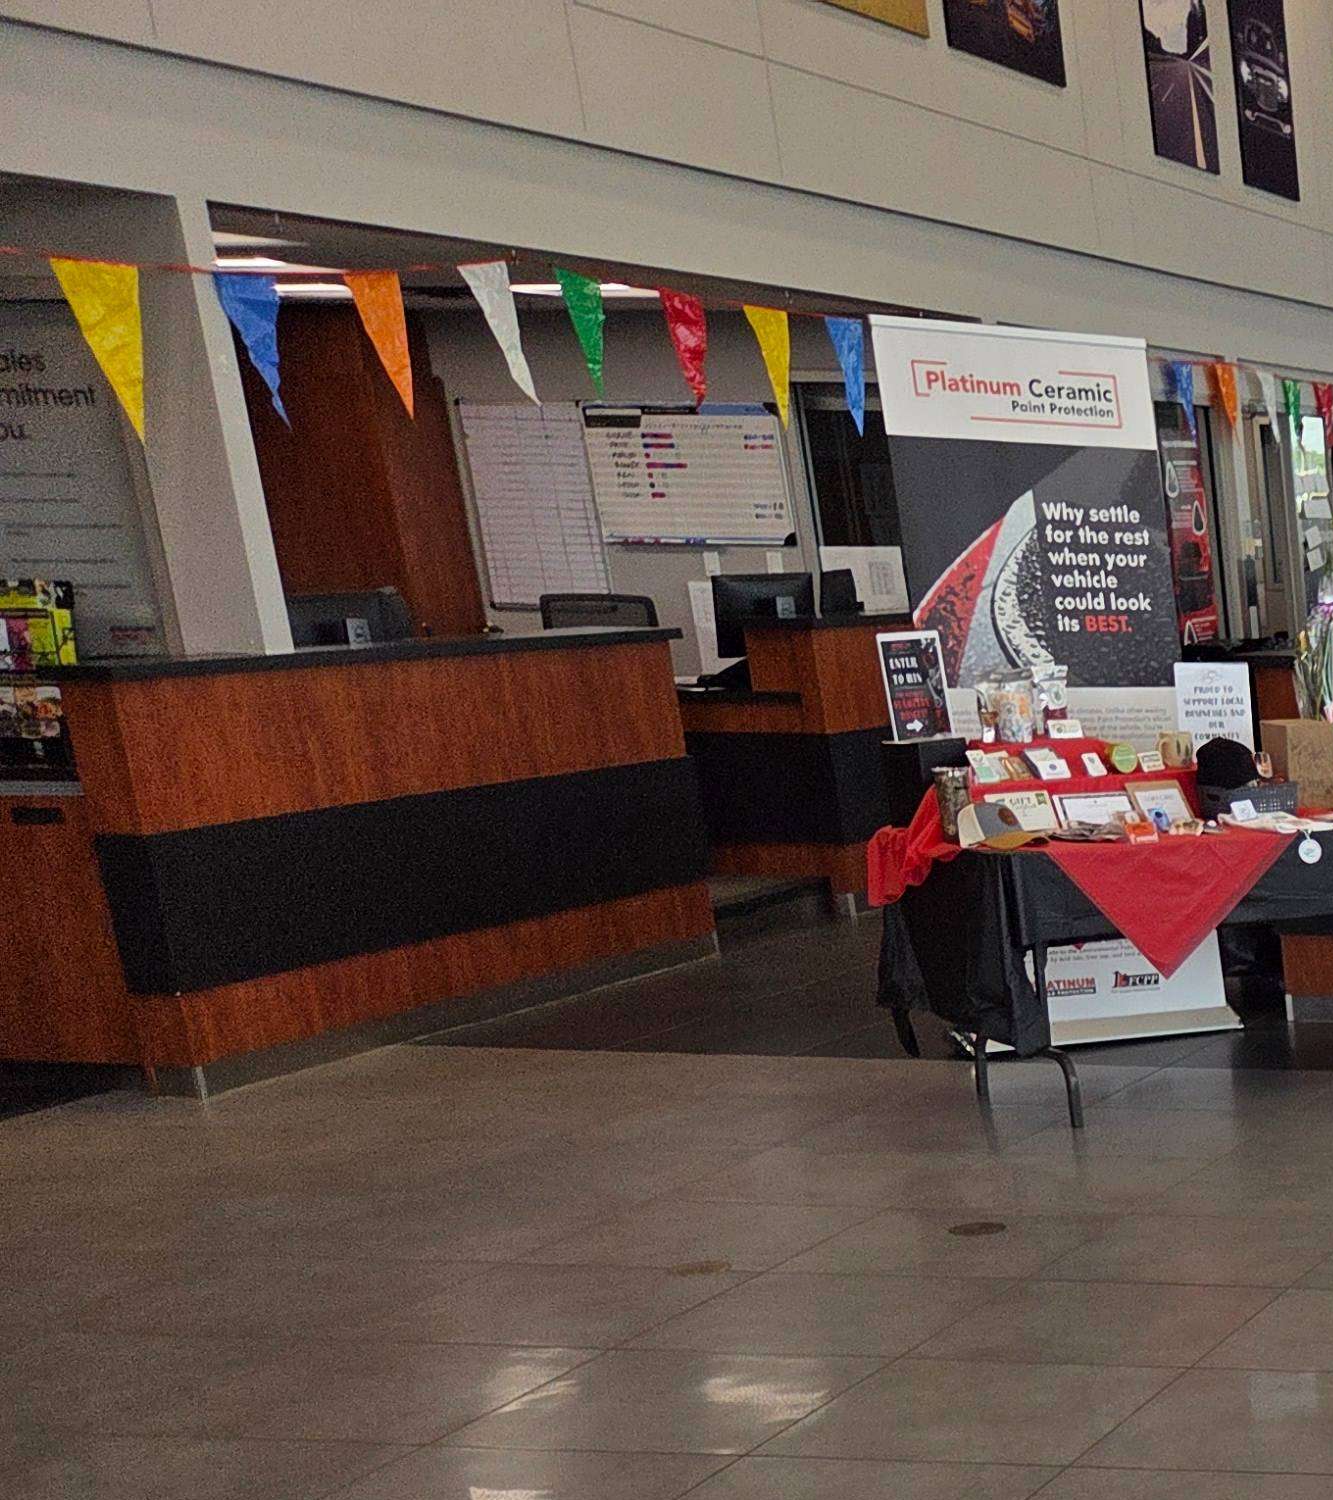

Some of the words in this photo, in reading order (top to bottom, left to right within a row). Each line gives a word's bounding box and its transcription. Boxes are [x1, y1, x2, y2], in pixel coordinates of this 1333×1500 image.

[925, 371, 1021, 396] Platinum
[1029, 379, 1113, 403] Ceramic
[1011, 401, 1045, 414] Paint
[1050, 403, 1114, 418] Protection
[1042, 502, 1084, 526] Why
[1089, 505, 1140, 523] settle
[1045, 524, 1073, 543] for
[1078, 525, 1108, 544] the
[1114, 529, 1149, 545] rest
[1048, 547, 1100, 566] when
[1105, 553, 1147, 571] your
[1051, 569, 1118, 589] vehicle
[1055, 592, 1105, 611] could
[1110, 592, 1152, 611] look
[1057, 614, 1080, 632] its
[1085, 615, 1132, 633] BEST.
[1046, 977, 1096, 991] ATINUM
